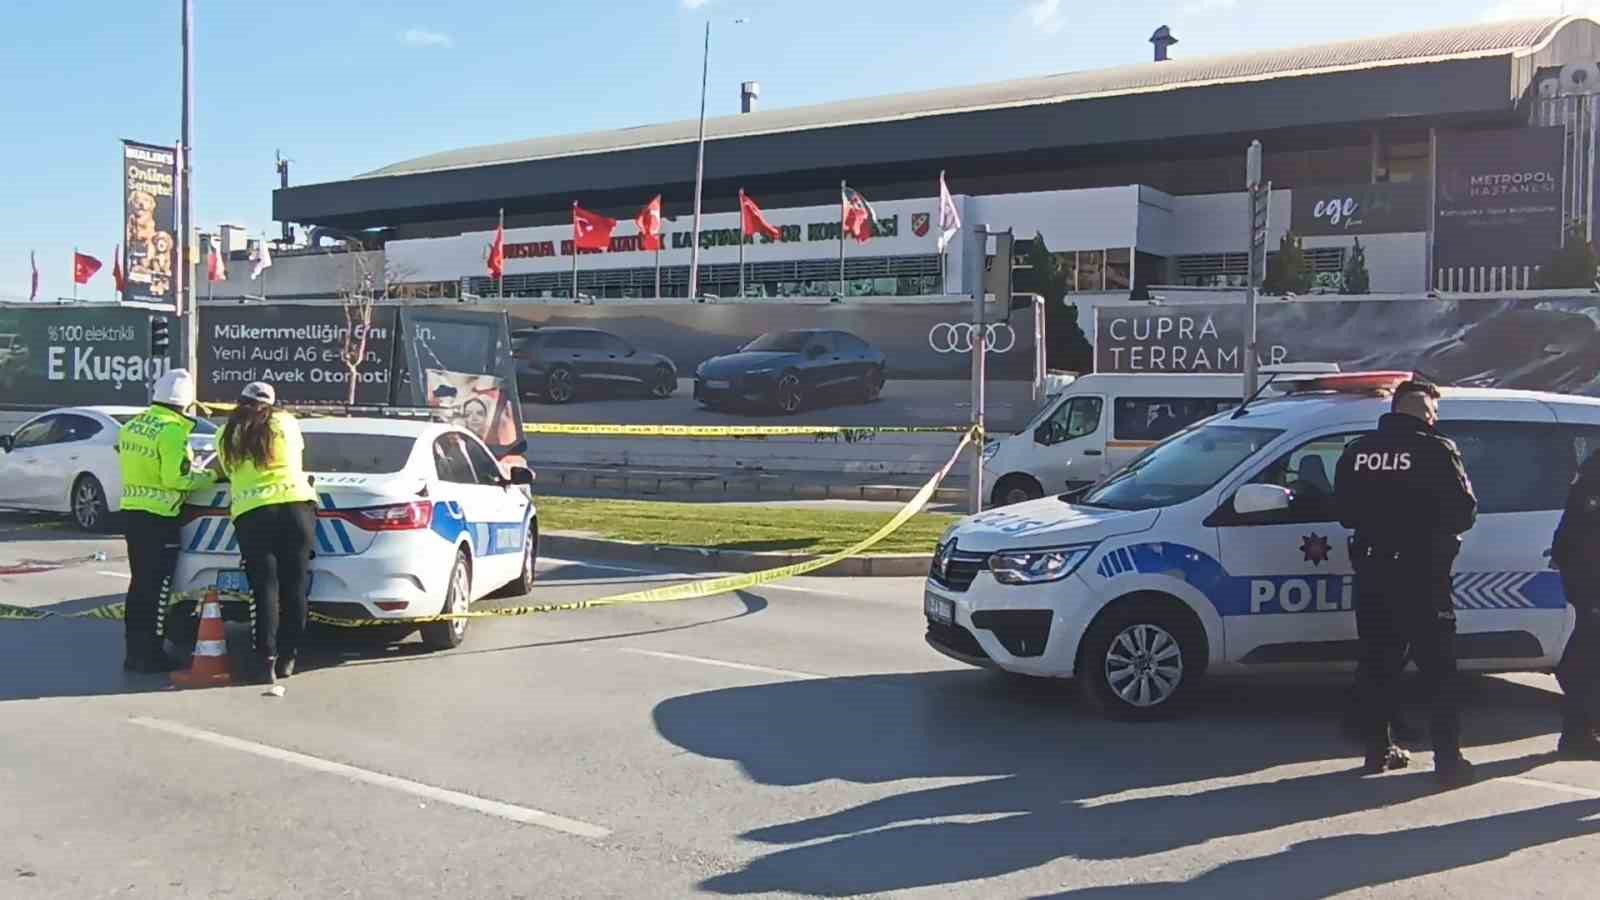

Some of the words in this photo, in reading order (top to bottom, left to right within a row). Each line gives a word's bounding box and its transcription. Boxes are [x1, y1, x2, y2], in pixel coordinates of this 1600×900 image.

[1471, 171, 1554, 185] METROPOL
[1313, 197, 1359, 225] ege
[48, 326, 82, 341] %100
[85, 324, 135, 341] elektrikli
[1109, 314, 1219, 341] CUPRA
[213, 346, 246, 360] Yeni
[251, 346, 289, 361] Audi
[294, 346, 317, 361] A6
[48, 346, 65, 380] E
[212, 368, 257, 384] şimdi
[262, 368, 305, 382] Avek
[310, 367, 391, 383] Otomoti
